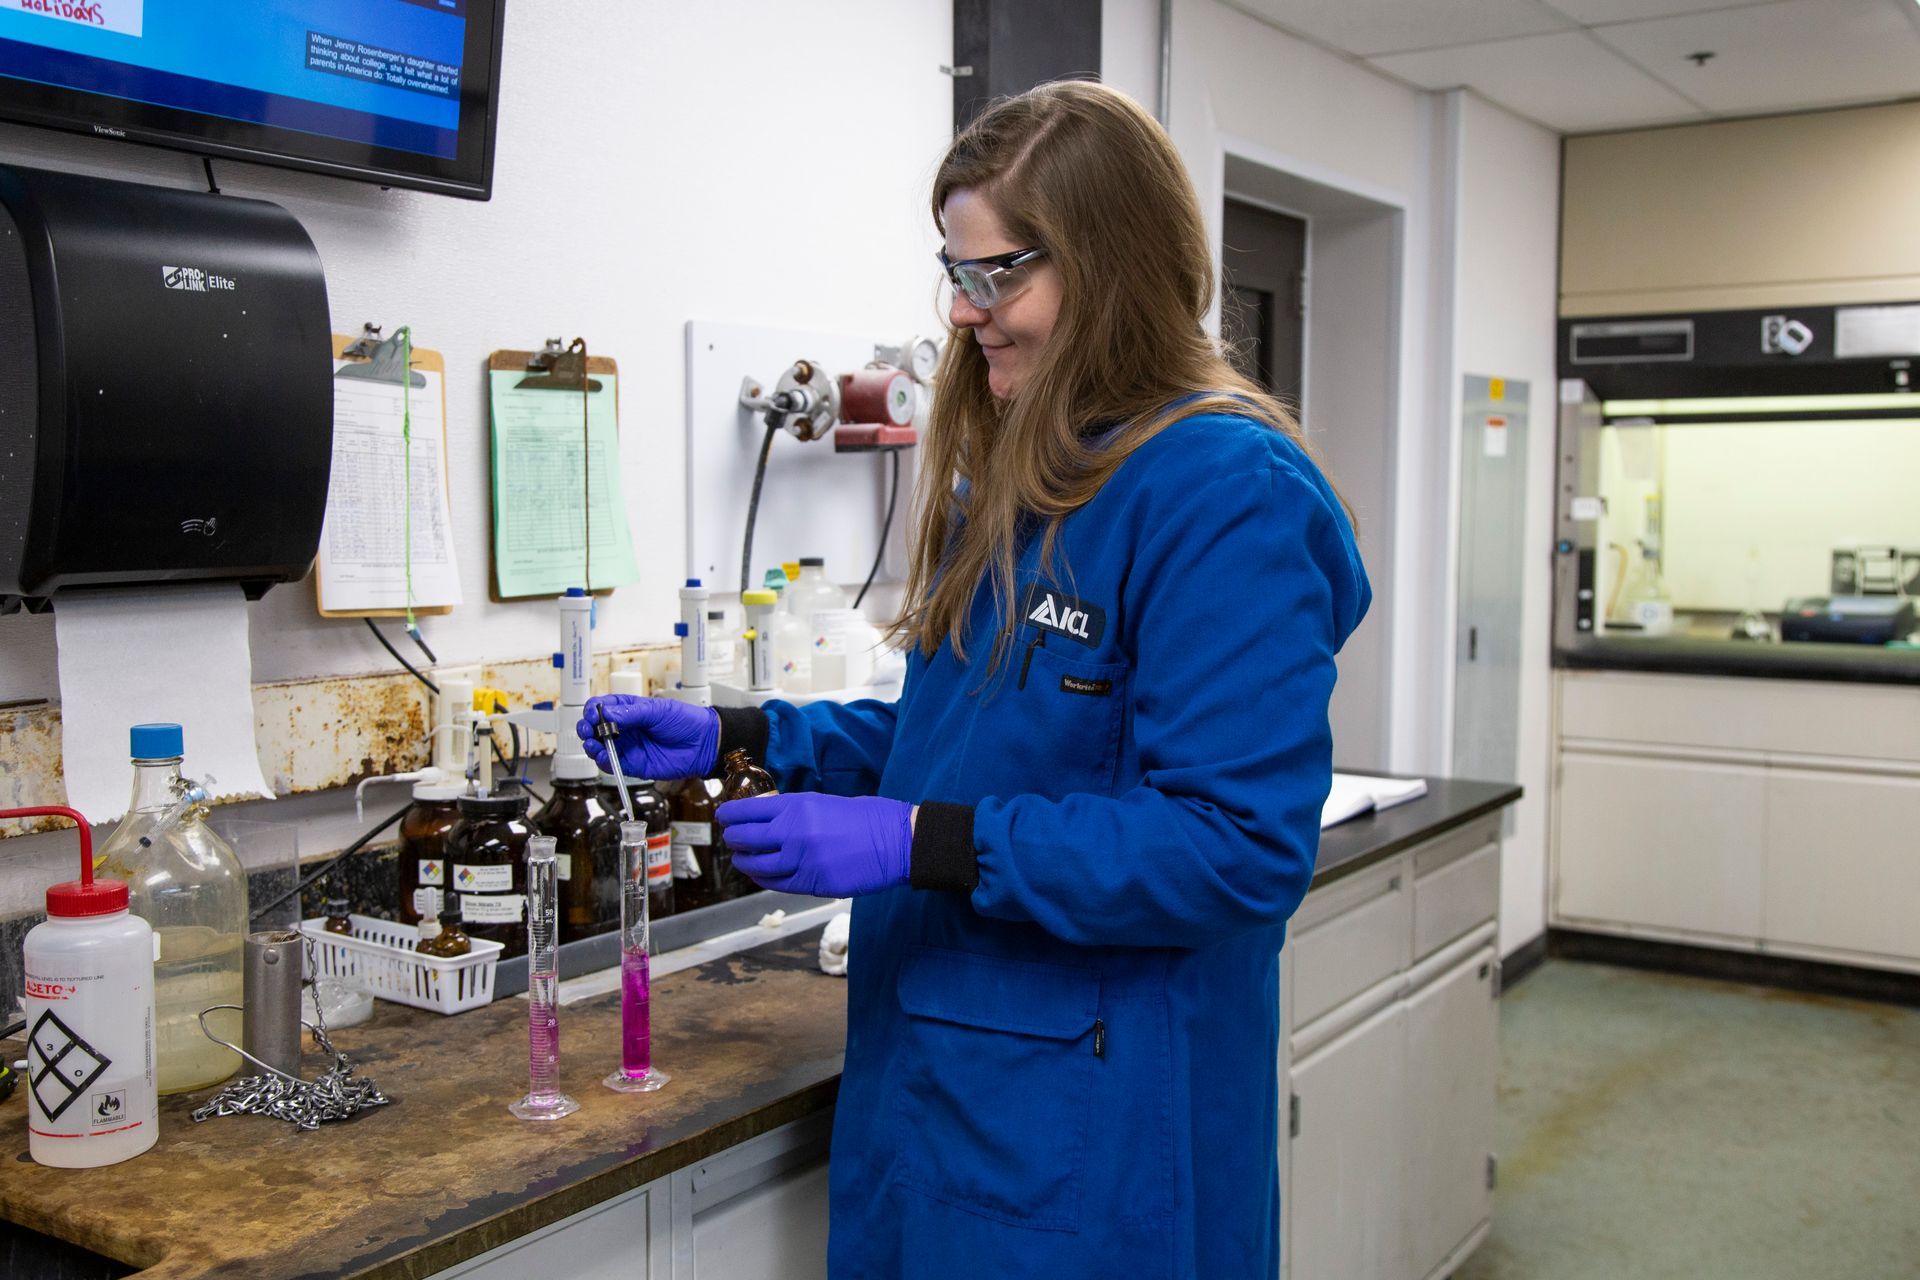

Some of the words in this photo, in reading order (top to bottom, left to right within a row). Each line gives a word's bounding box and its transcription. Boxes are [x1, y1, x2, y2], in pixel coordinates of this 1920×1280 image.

[311, 33, 332, 46] When
[334, 40, 355, 53] Jenny
[357, 45, 405, 64] Rosenberger's
[407, 57, 435, 70] daughter
[437, 64, 459, 76] started
[310, 45, 338, 60] thinking
[340, 52, 360, 64] about
[362, 57, 388, 71] college,
[390, 63, 402, 74] she
[404, 66, 415, 76] felt
[416, 70, 433, 80] what
[441, 75, 449, 84] lot
[450, 78, 458, 86] of
[310, 57, 336, 70] parents
[338, 62, 344, 71] in
[345, 64, 372, 78] America
[386, 72, 406, 86] Totally
[407, 79, 450, 95] overwhelmed.
[94, 124, 126, 137] ViewSonic
[184, 279, 206, 292] LINK
[209, 275, 235, 290] Elite
[545, 908, 554, 917] 50
[547, 1018, 556, 1027] 20
[46, 1043, 54, 1051] 3
[74, 1069, 83, 1078] 0
